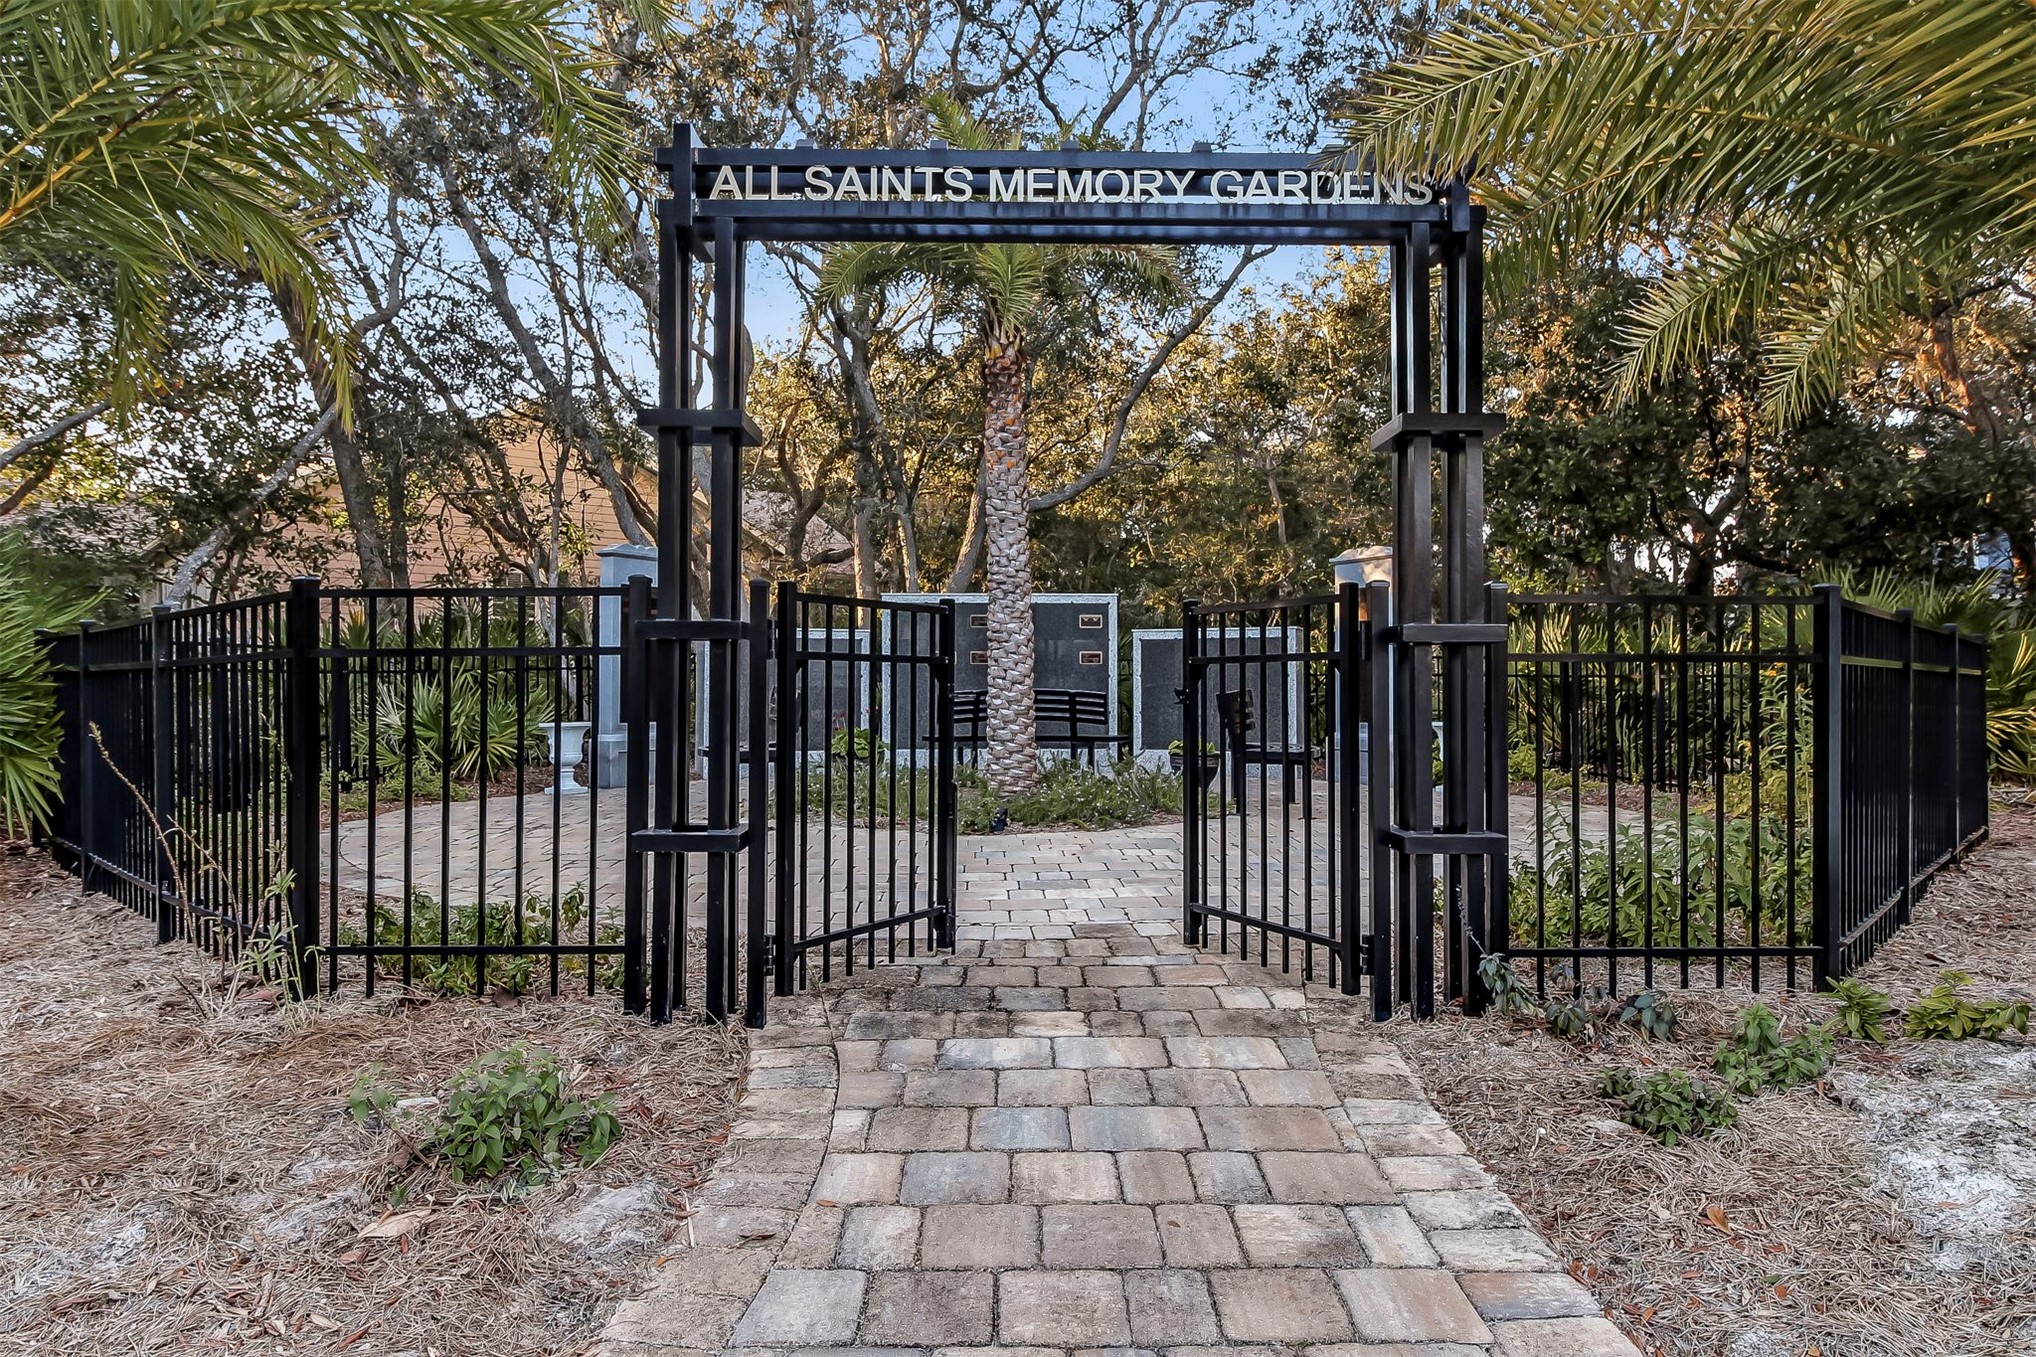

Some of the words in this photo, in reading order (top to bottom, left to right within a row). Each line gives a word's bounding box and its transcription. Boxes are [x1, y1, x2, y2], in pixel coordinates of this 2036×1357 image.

[709, 165, 789, 200] ALL
[804, 165, 973, 202] SAINTS
[989, 168, 1195, 204] MEMORY
[1210, 170, 1433, 205] GARDENS
